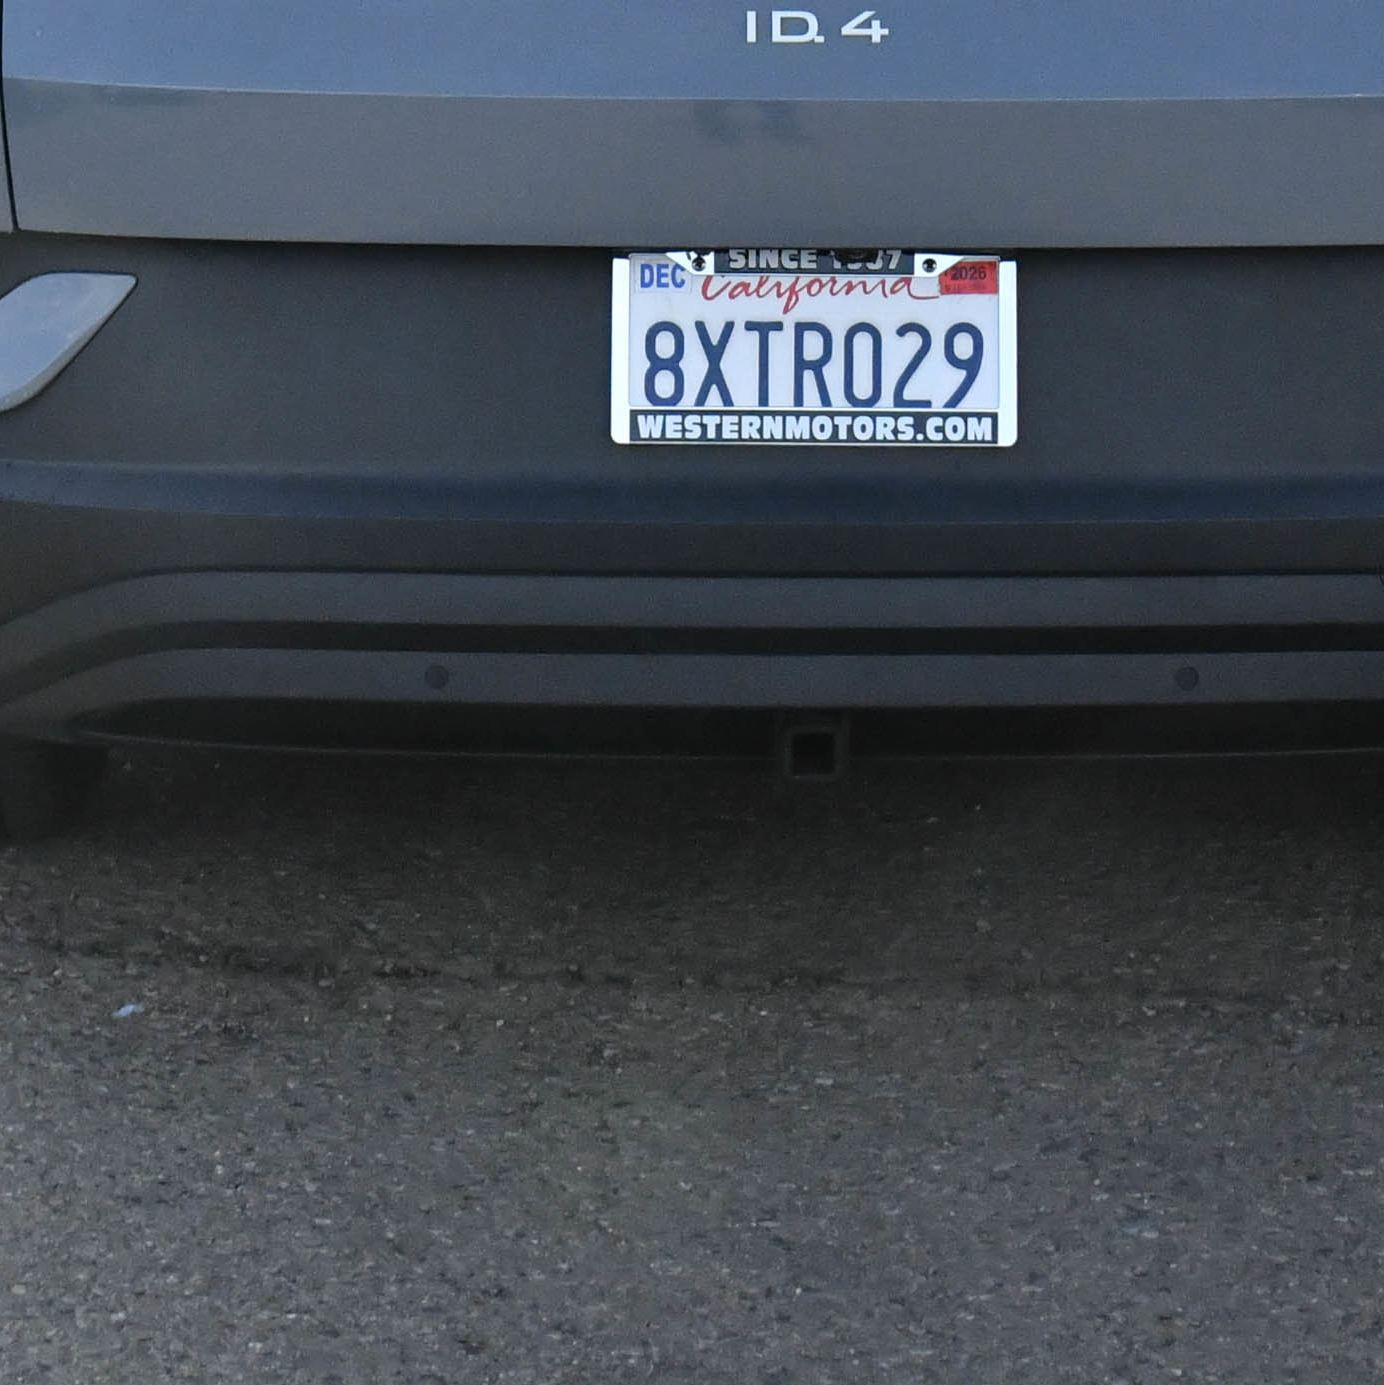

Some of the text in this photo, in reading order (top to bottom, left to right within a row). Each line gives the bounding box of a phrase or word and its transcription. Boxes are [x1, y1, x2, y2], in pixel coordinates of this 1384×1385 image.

[728, 249, 817, 269] SINCE
[640, 263, 686, 289] DEC
[951, 266, 987, 281] 2026
[644, 320, 984, 408] 8XTR029
[637, 415, 992, 441] WESTERNMOTORS.COM
